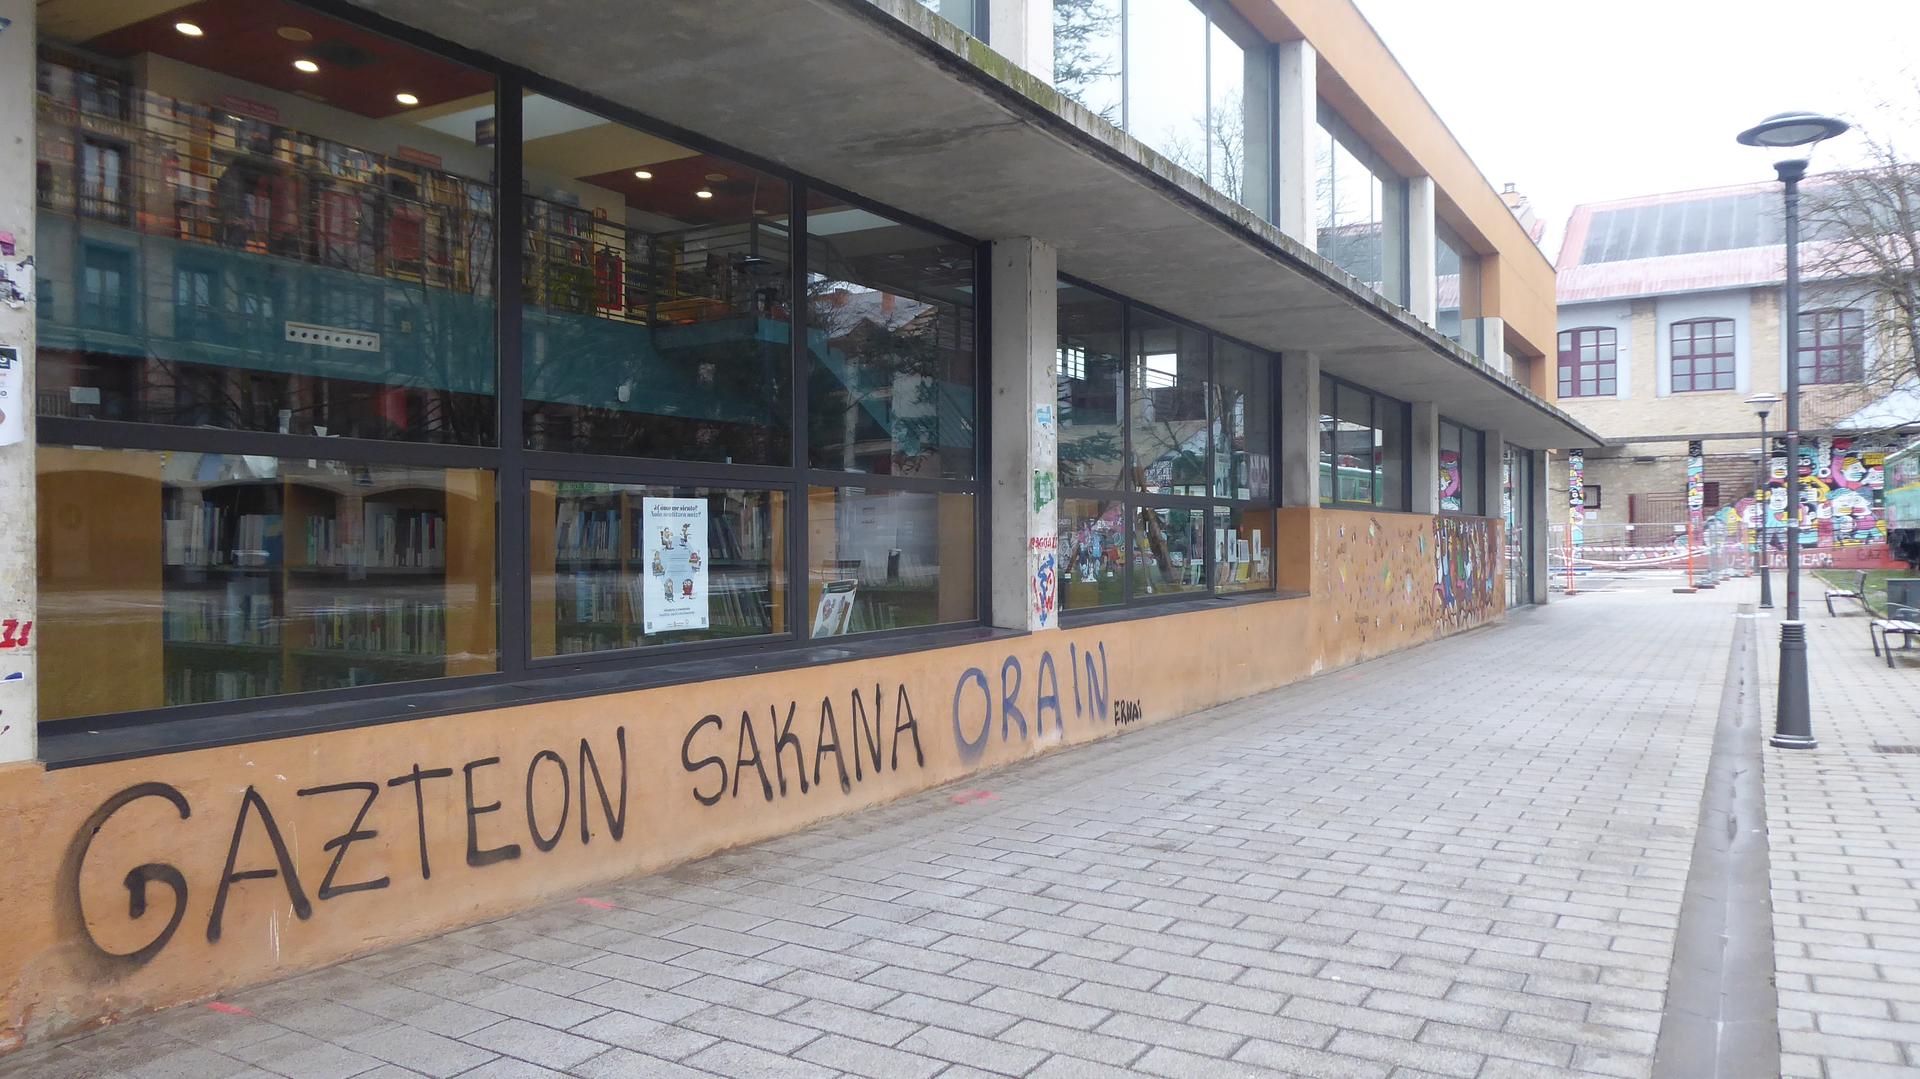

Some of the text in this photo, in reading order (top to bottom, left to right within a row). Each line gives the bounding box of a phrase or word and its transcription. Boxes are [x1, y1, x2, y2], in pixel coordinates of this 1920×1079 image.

[75, 640, 1110, 965] GAZTEON SAKANA ORAIN
